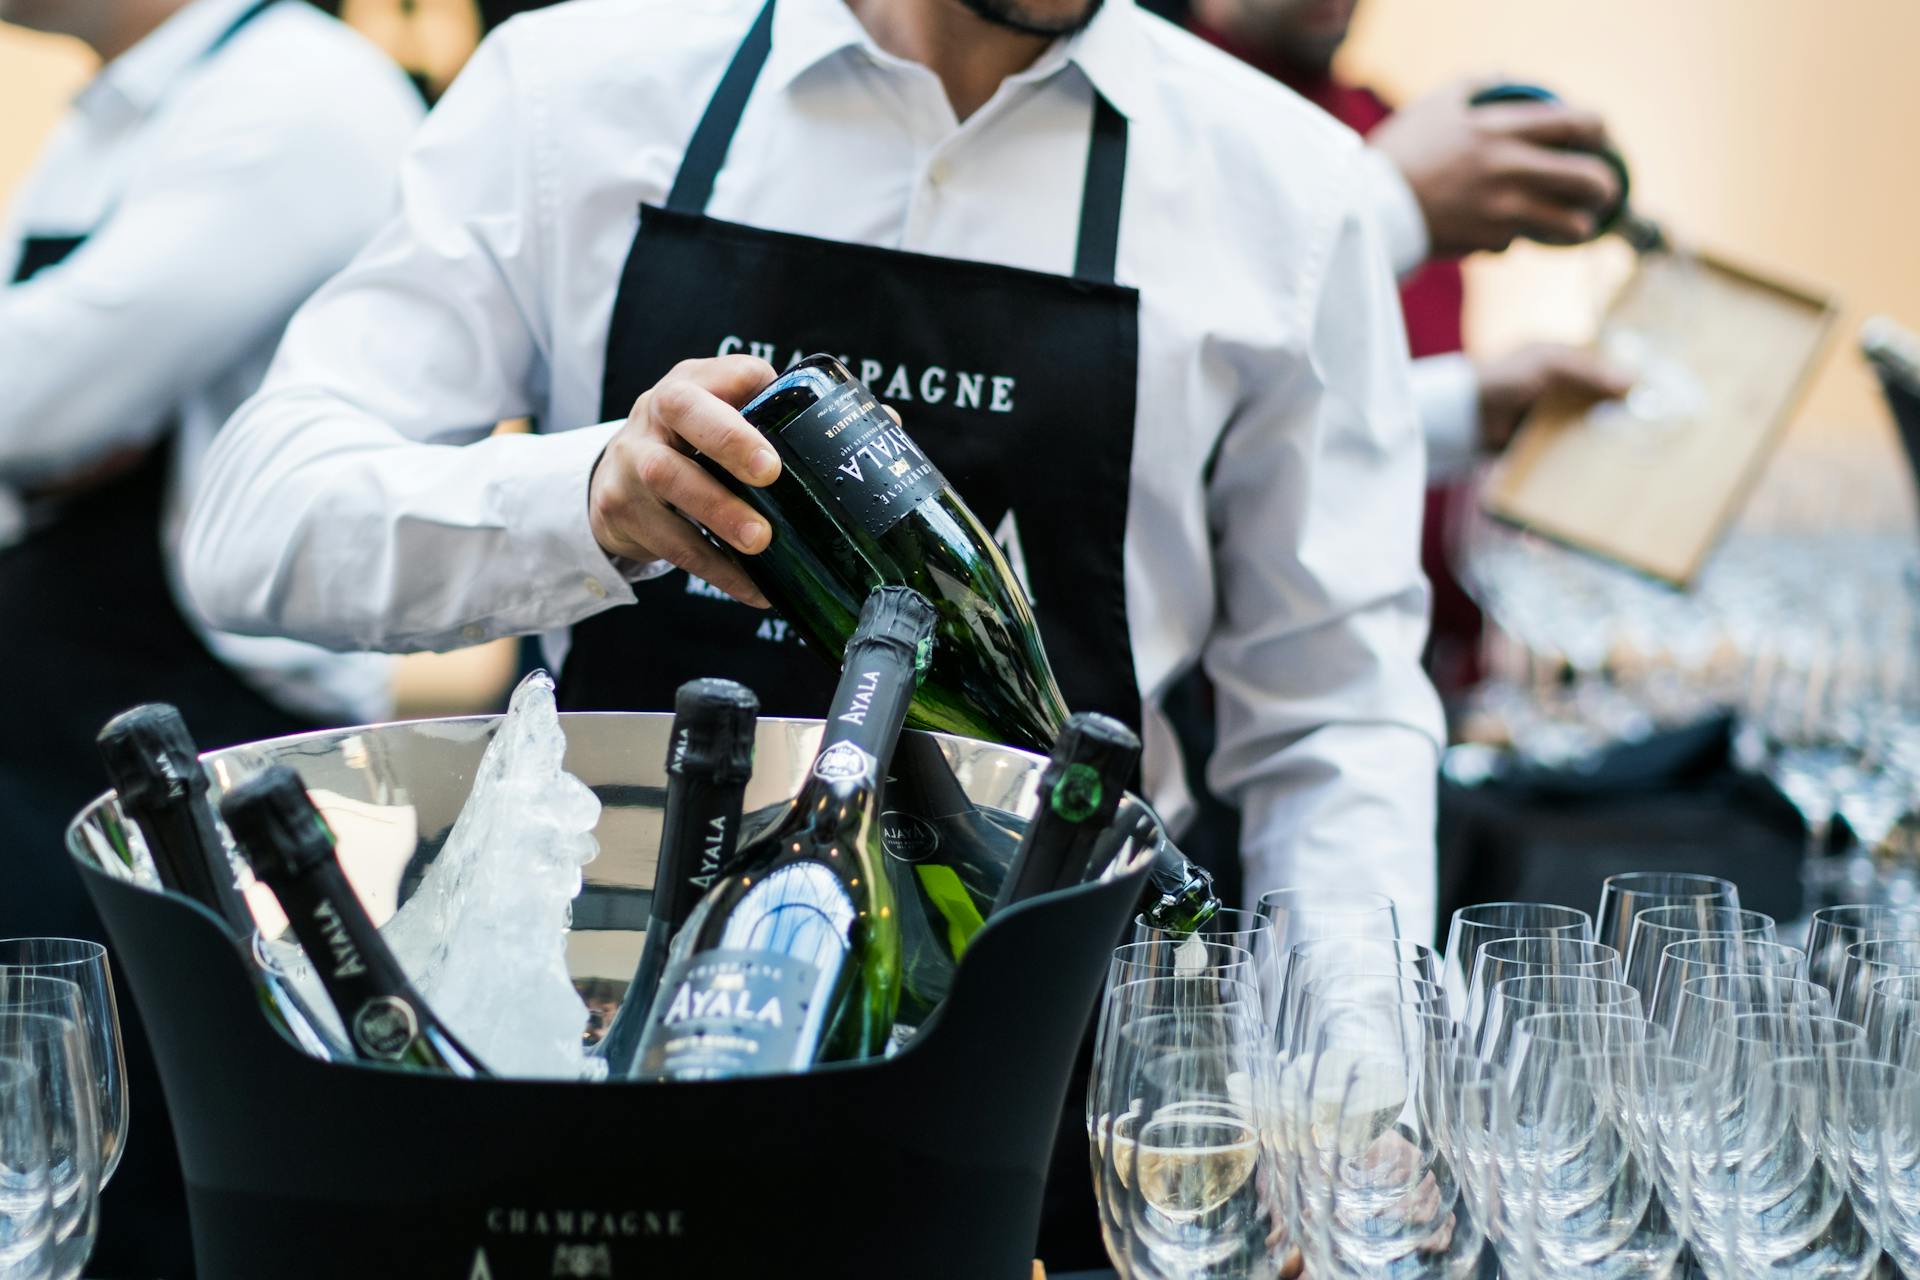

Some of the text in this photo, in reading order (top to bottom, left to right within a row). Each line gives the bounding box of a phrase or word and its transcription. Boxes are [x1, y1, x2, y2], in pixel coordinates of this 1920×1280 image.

[717, 334, 1016, 413] CHAPAGNE
[824, 411, 861, 439] MAJEUR
[838, 425, 925, 482] AYALA
[838, 671, 880, 726] AYALA
[671, 728, 689, 773] AYALA
[689, 816, 727, 889] AYALA
[313, 901, 367, 979] AYALA
[663, 981, 783, 1028] AYALA
[485, 1207, 685, 1236] CHAMPAGNE
